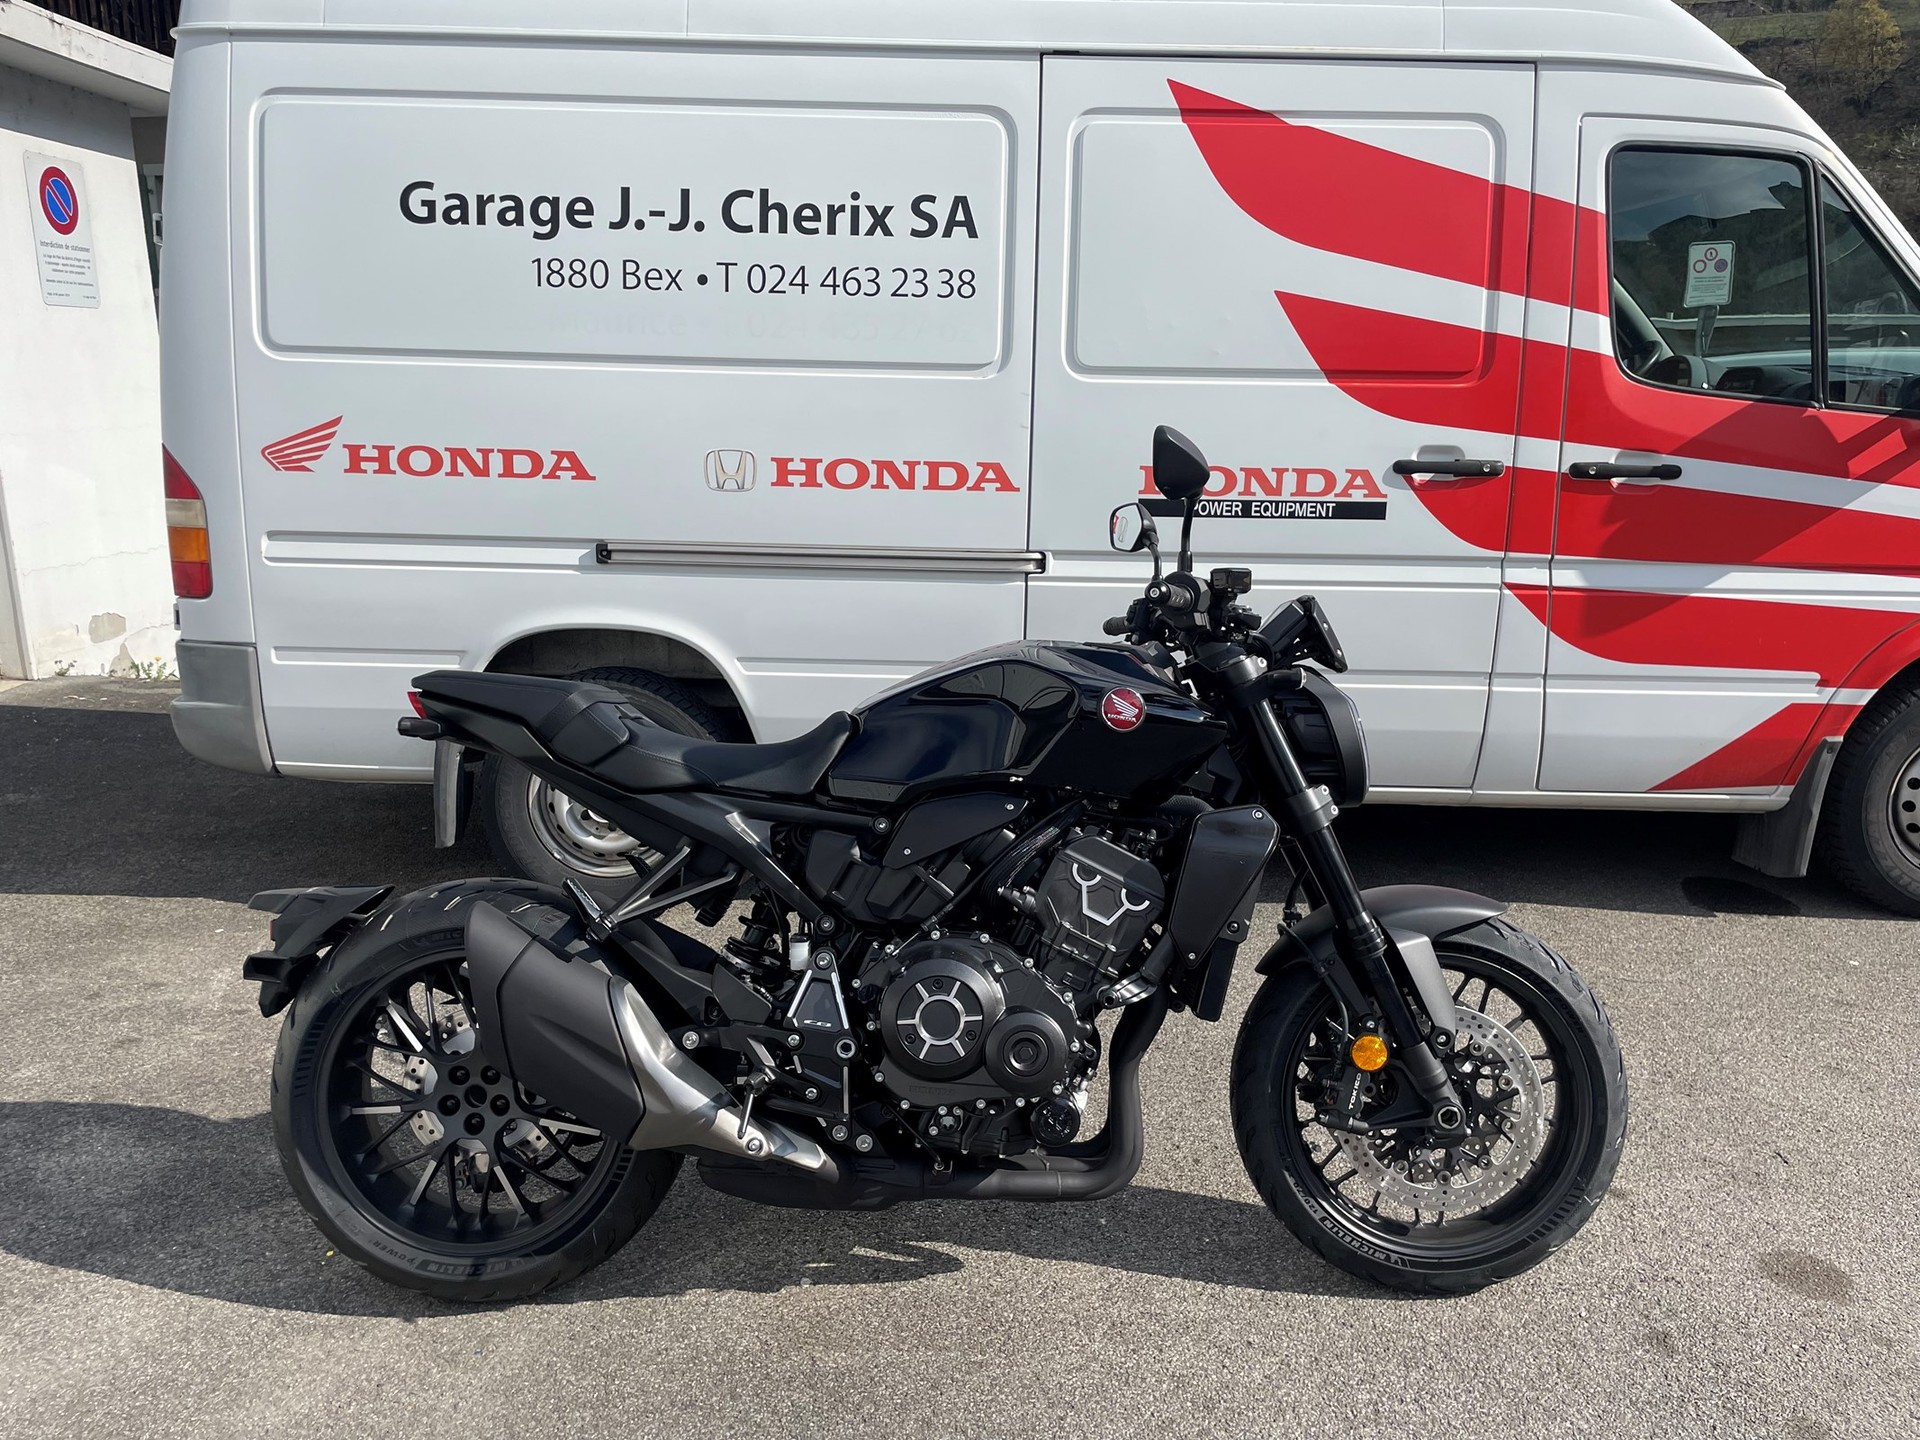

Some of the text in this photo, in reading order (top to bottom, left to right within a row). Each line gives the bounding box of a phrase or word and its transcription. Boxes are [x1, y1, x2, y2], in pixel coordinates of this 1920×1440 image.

[399, 180, 979, 241] Garage J.-J. Cherix SA
[531, 257, 976, 300] 1880 Bex T 024 463 23 38
[343, 443, 596, 481] HONDA
[770, 456, 1020, 493] HONDA
[1139, 465, 1388, 499] ONDA
[1251, 501, 1337, 518] EQUIPMENT
[1107, 713, 1137, 723] HONDA
[1348, 1073, 1362, 1110] TOKICO
[1323, 1219, 1387, 1261] MICHELIN
